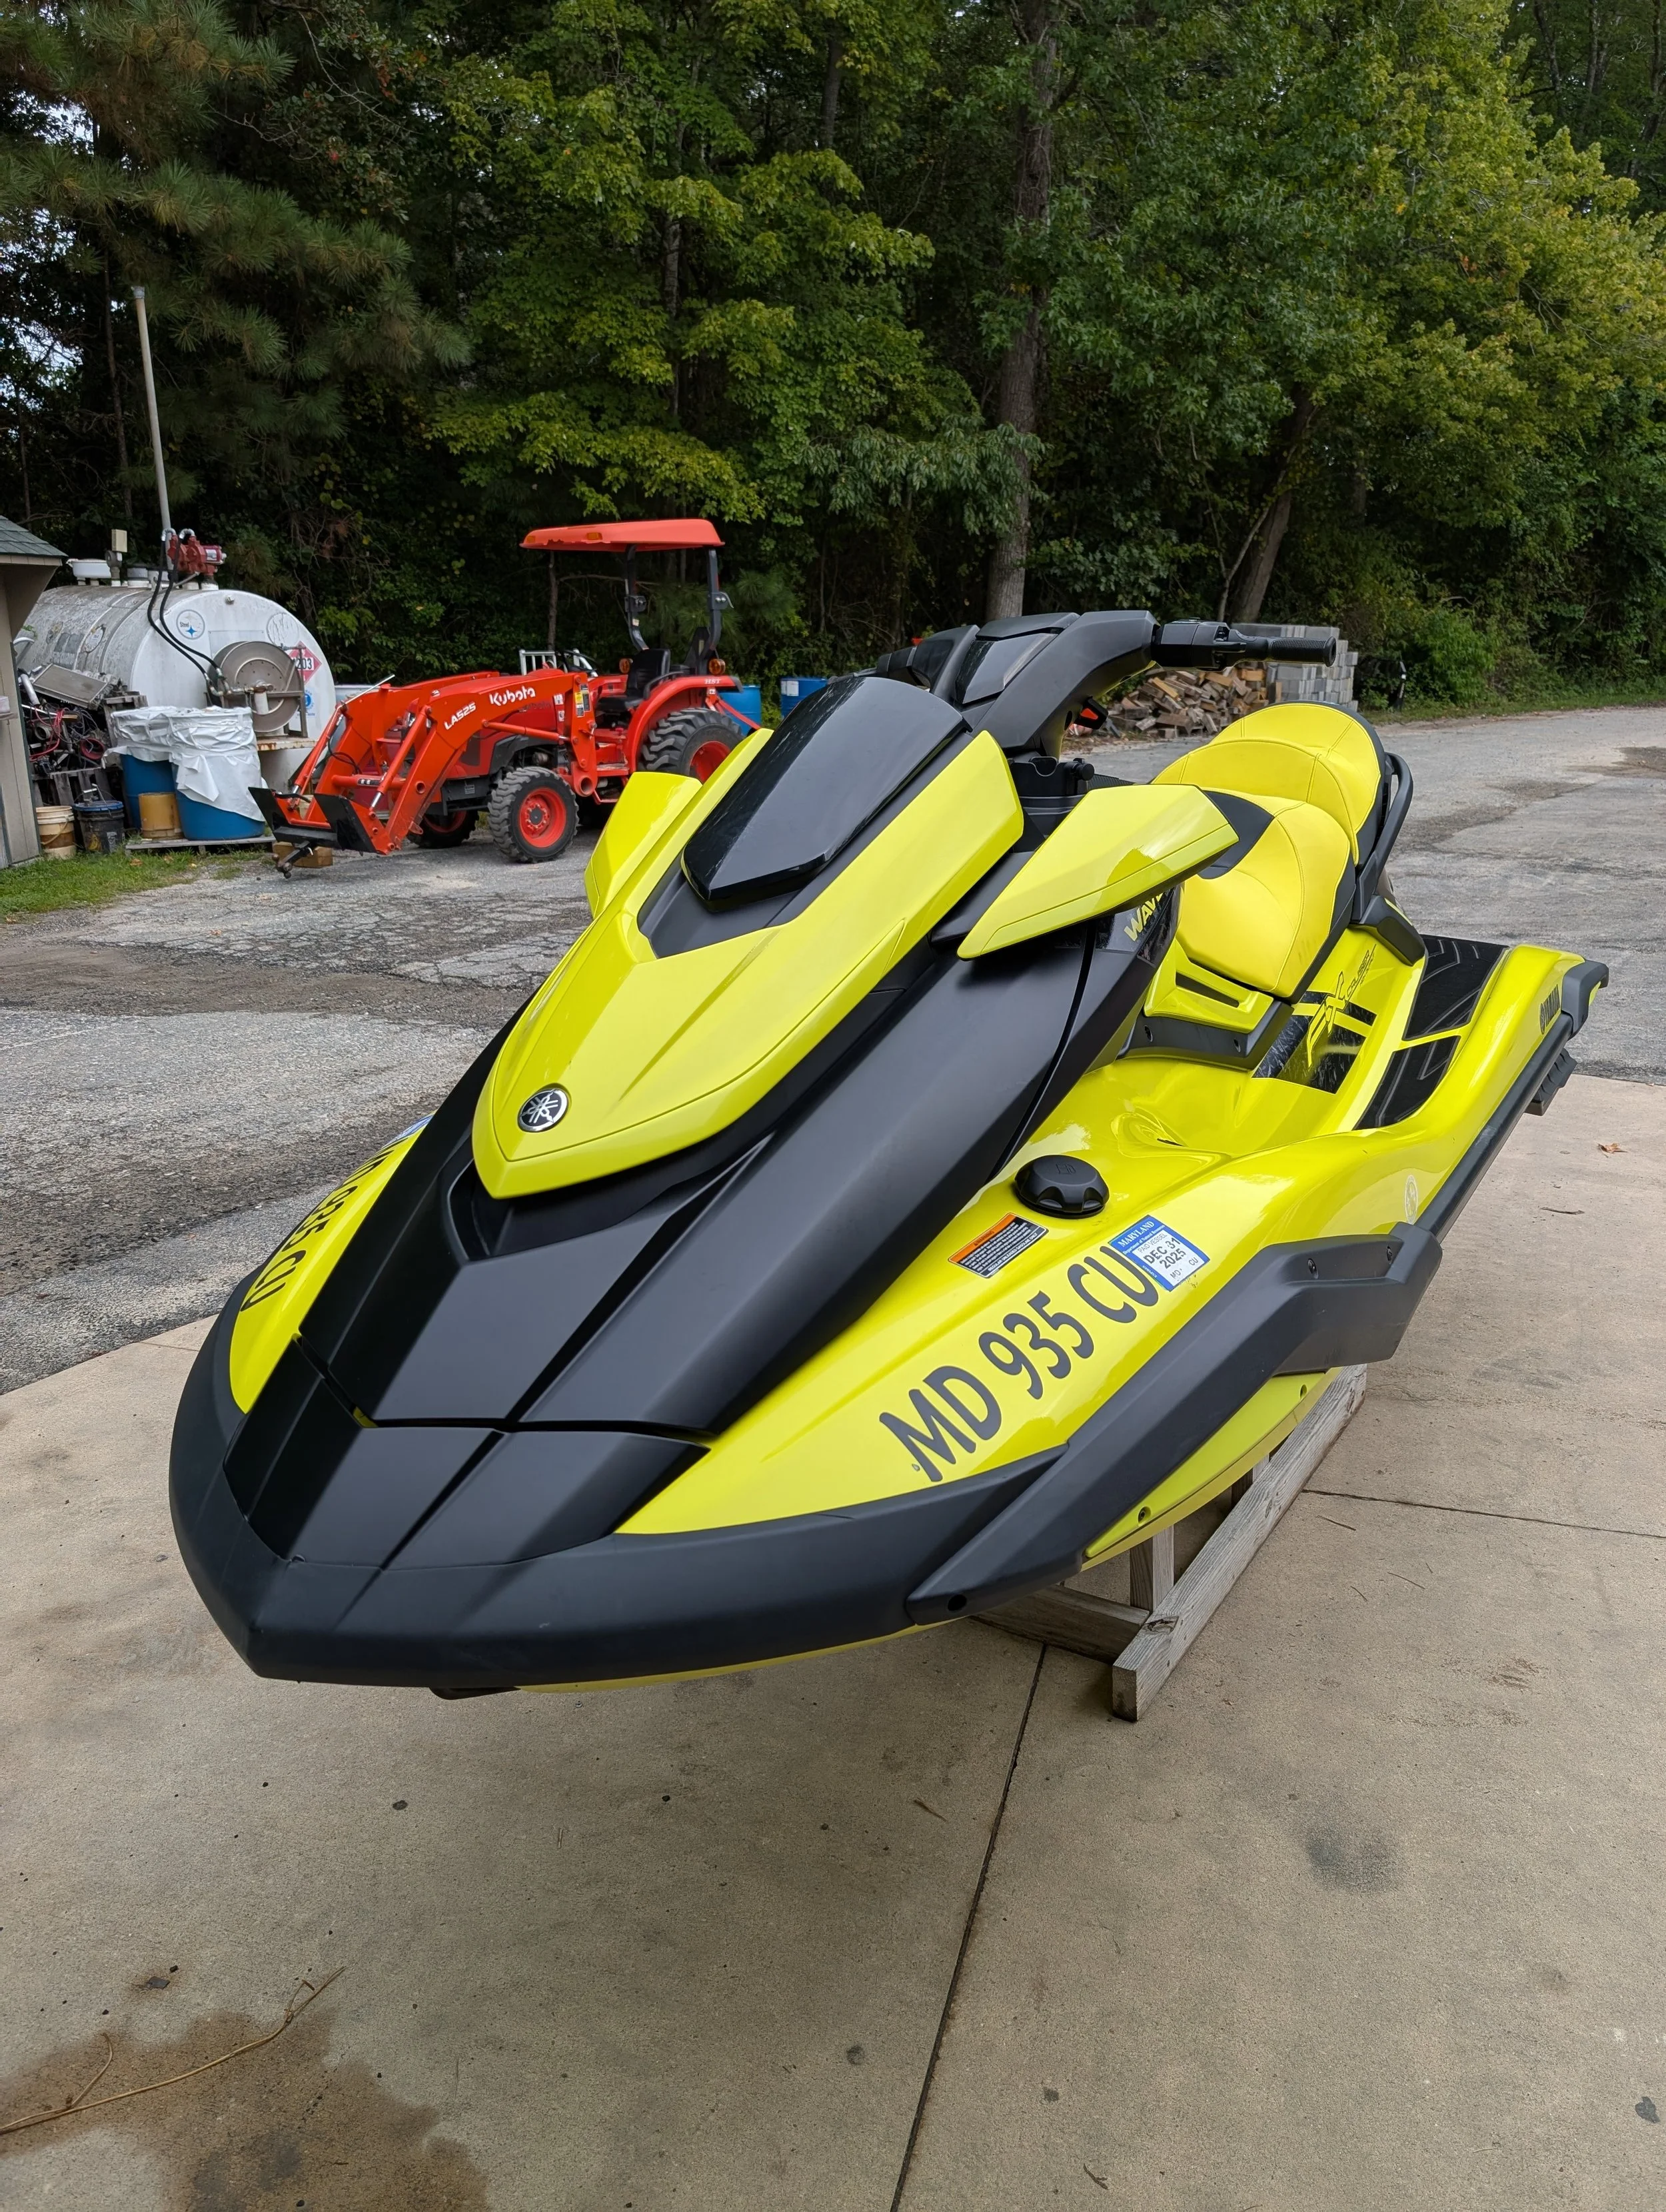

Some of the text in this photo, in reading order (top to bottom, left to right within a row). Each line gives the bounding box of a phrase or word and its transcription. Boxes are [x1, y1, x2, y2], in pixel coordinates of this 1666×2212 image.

[293, 658, 313, 670] 203
[488, 686, 536, 706] Kubota
[444, 701, 476, 730] LA525
[1118, 1221, 1155, 1247] MARYLAND
[1138, 1233, 1168, 1253] PAID VESSEL
[1144, 1237, 1180, 1264] DEC 31
[1160, 1248, 1186, 1269] 2025
[1189, 1257, 1199, 1266] CU
[240, 1250, 307, 1312] CU
[879, 1365, 1002, 1482] MD
[978, 1290, 1094, 1400] 935
[1067, 1246, 1159, 1323] CU
